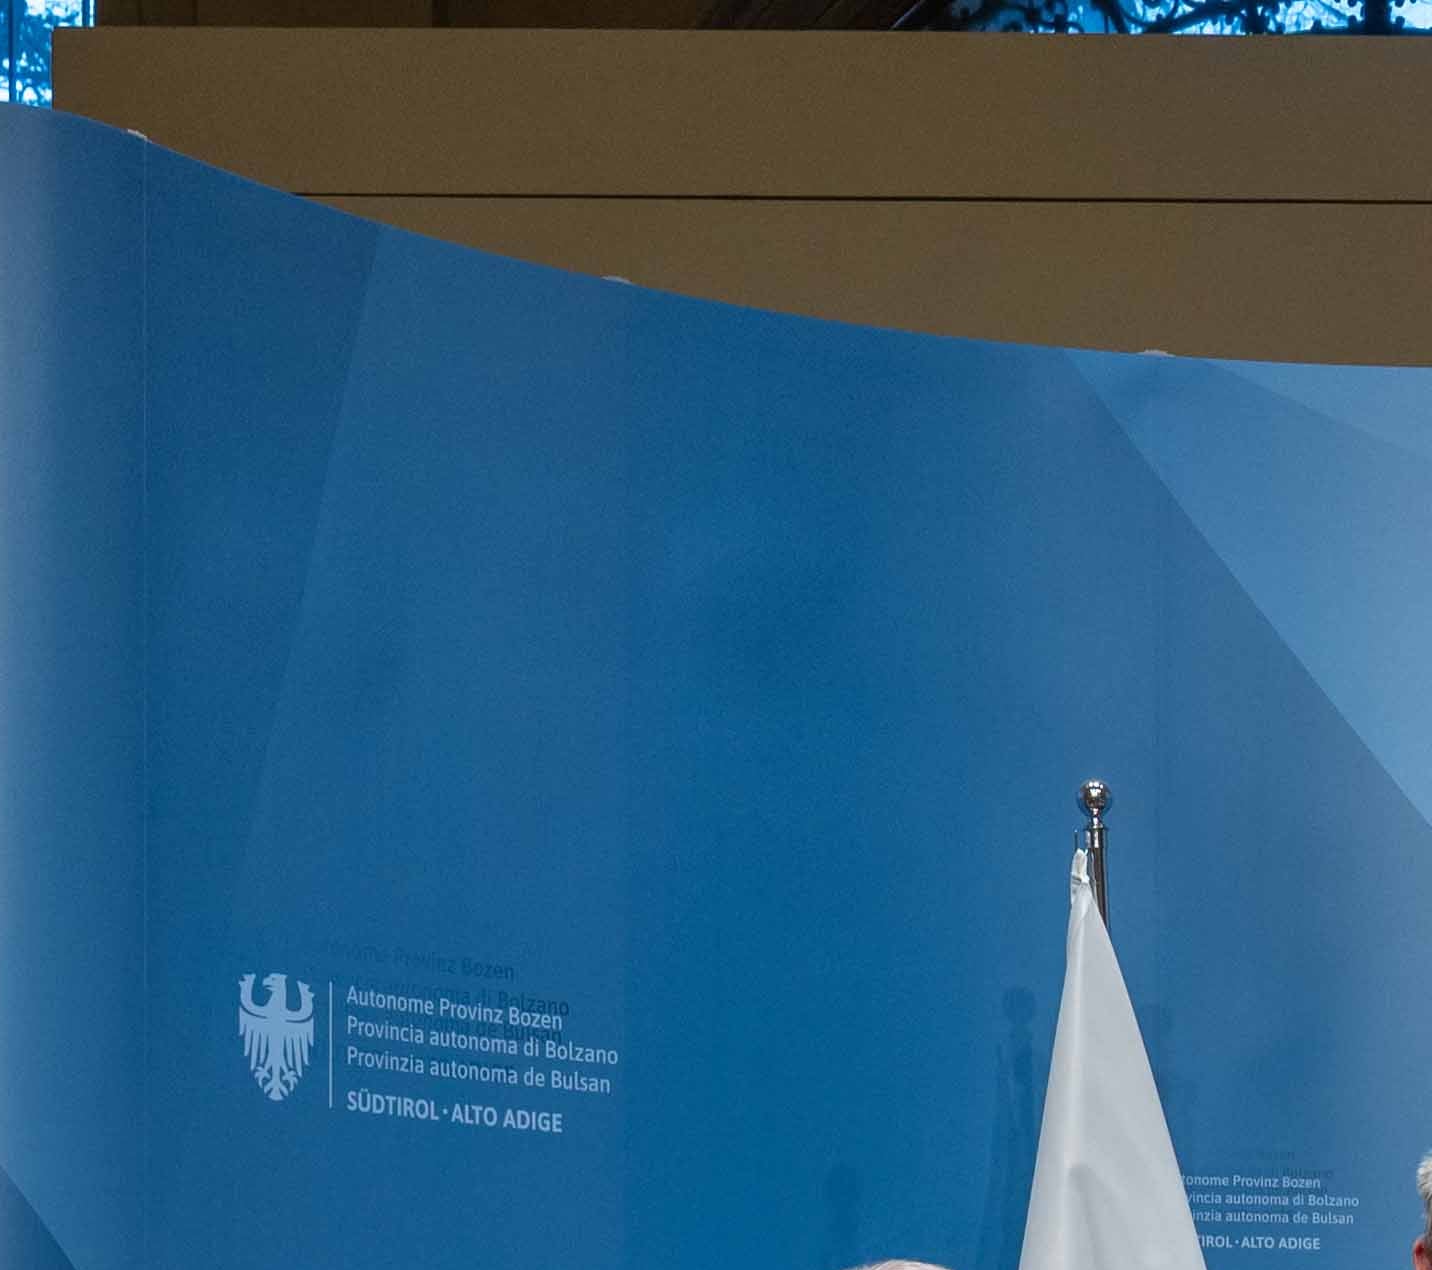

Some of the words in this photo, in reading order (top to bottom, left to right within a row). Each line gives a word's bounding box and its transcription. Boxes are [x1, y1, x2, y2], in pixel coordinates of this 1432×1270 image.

[347, 986, 434, 1015] Autonome
[440, 998, 503, 1023] Provinz
[509, 1007, 562, 1030] Bozen
[348, 1015, 424, 1044] Provincia
[430, 1031, 517, 1054] autonoma
[524, 1036, 539, 1056] di
[546, 1040, 618, 1064] Bolzano
[348, 1046, 424, 1074] Provinzia
[430, 1061, 517, 1084] autonoma
[524, 1067, 544, 1086] de
[552, 1070, 610, 1093] Bulsan
[348, 1088, 439, 1120] SÜDTIROL
[451, 1104, 497, 1126] ALTO
[503, 1109, 562, 1133] ADIGE
[1233, 1175, 1278, 1188] Provinz
[1283, 1176, 1320, 1188] Bozen
[1226, 1194, 1288, 1205] autonoma
[1309, 1194, 1359, 1207] Bolzano
[1226, 1212, 1288, 1223] autonoma
[1313, 1212, 1353, 1224] Bulsan
[1241, 1237, 1274, 1248] ALTO
[1279, 1237, 1320, 1250] ADIGE
